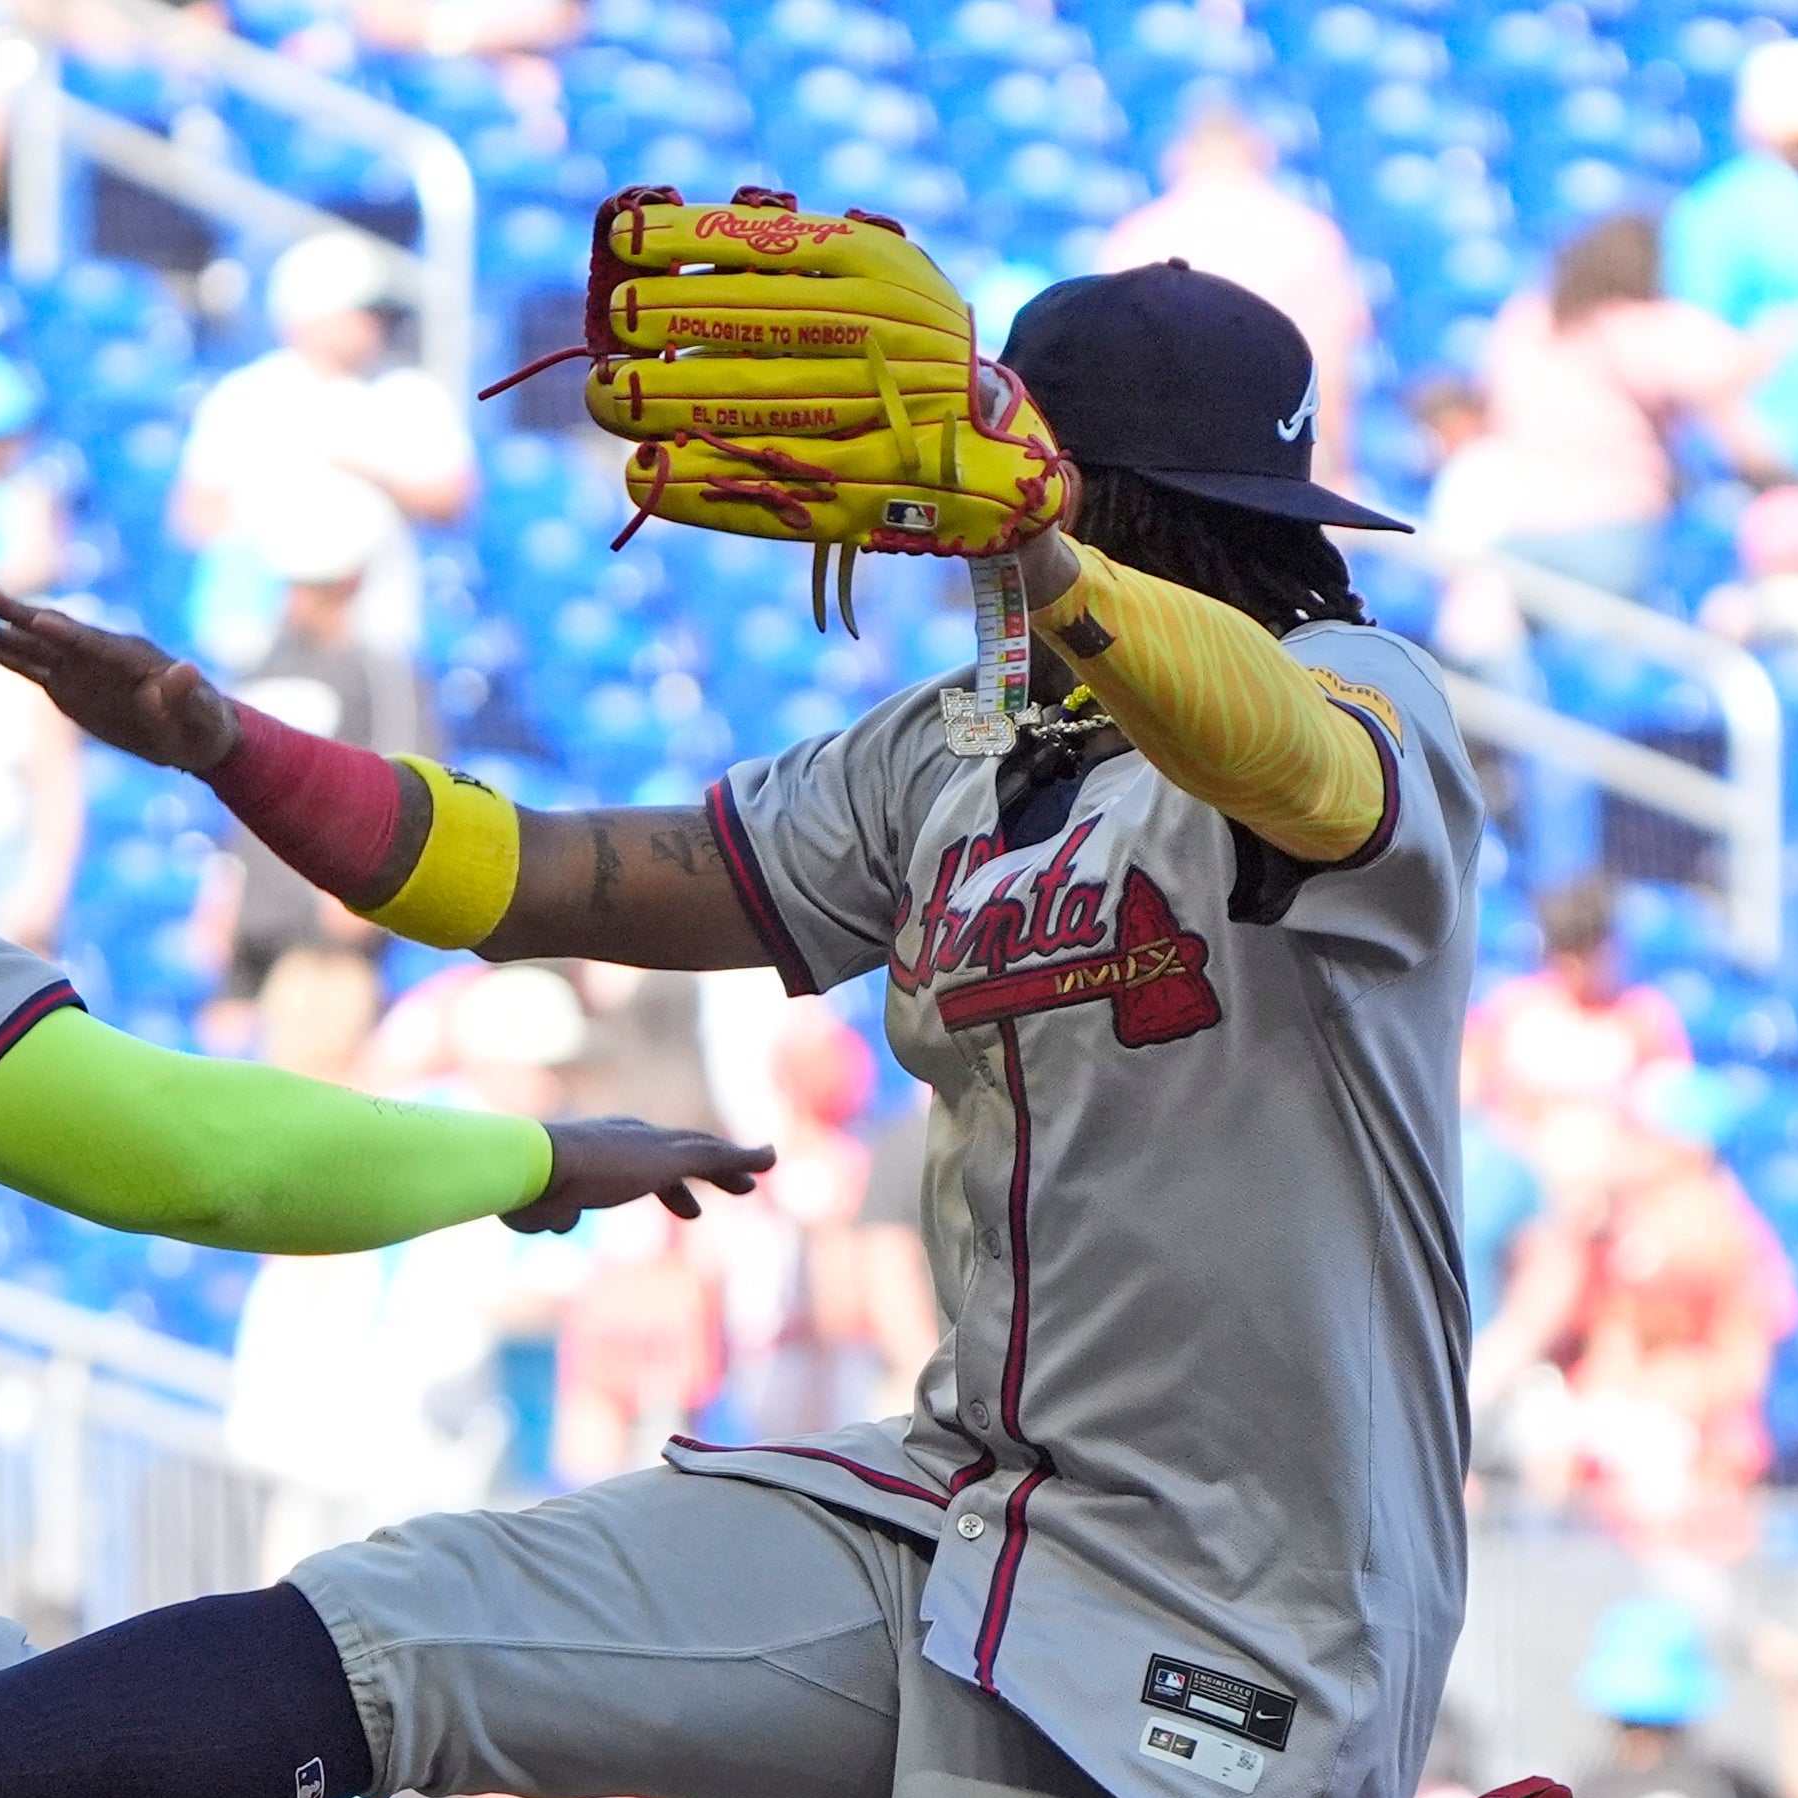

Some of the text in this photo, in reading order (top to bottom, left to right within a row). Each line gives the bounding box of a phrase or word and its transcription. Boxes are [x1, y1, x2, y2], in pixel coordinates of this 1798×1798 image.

[695, 210, 855, 245] Rawlings
[667, 315, 870, 345] APOLOGIZE TO NOBODY
[692, 404, 838, 429] EL DE LA SABANA
